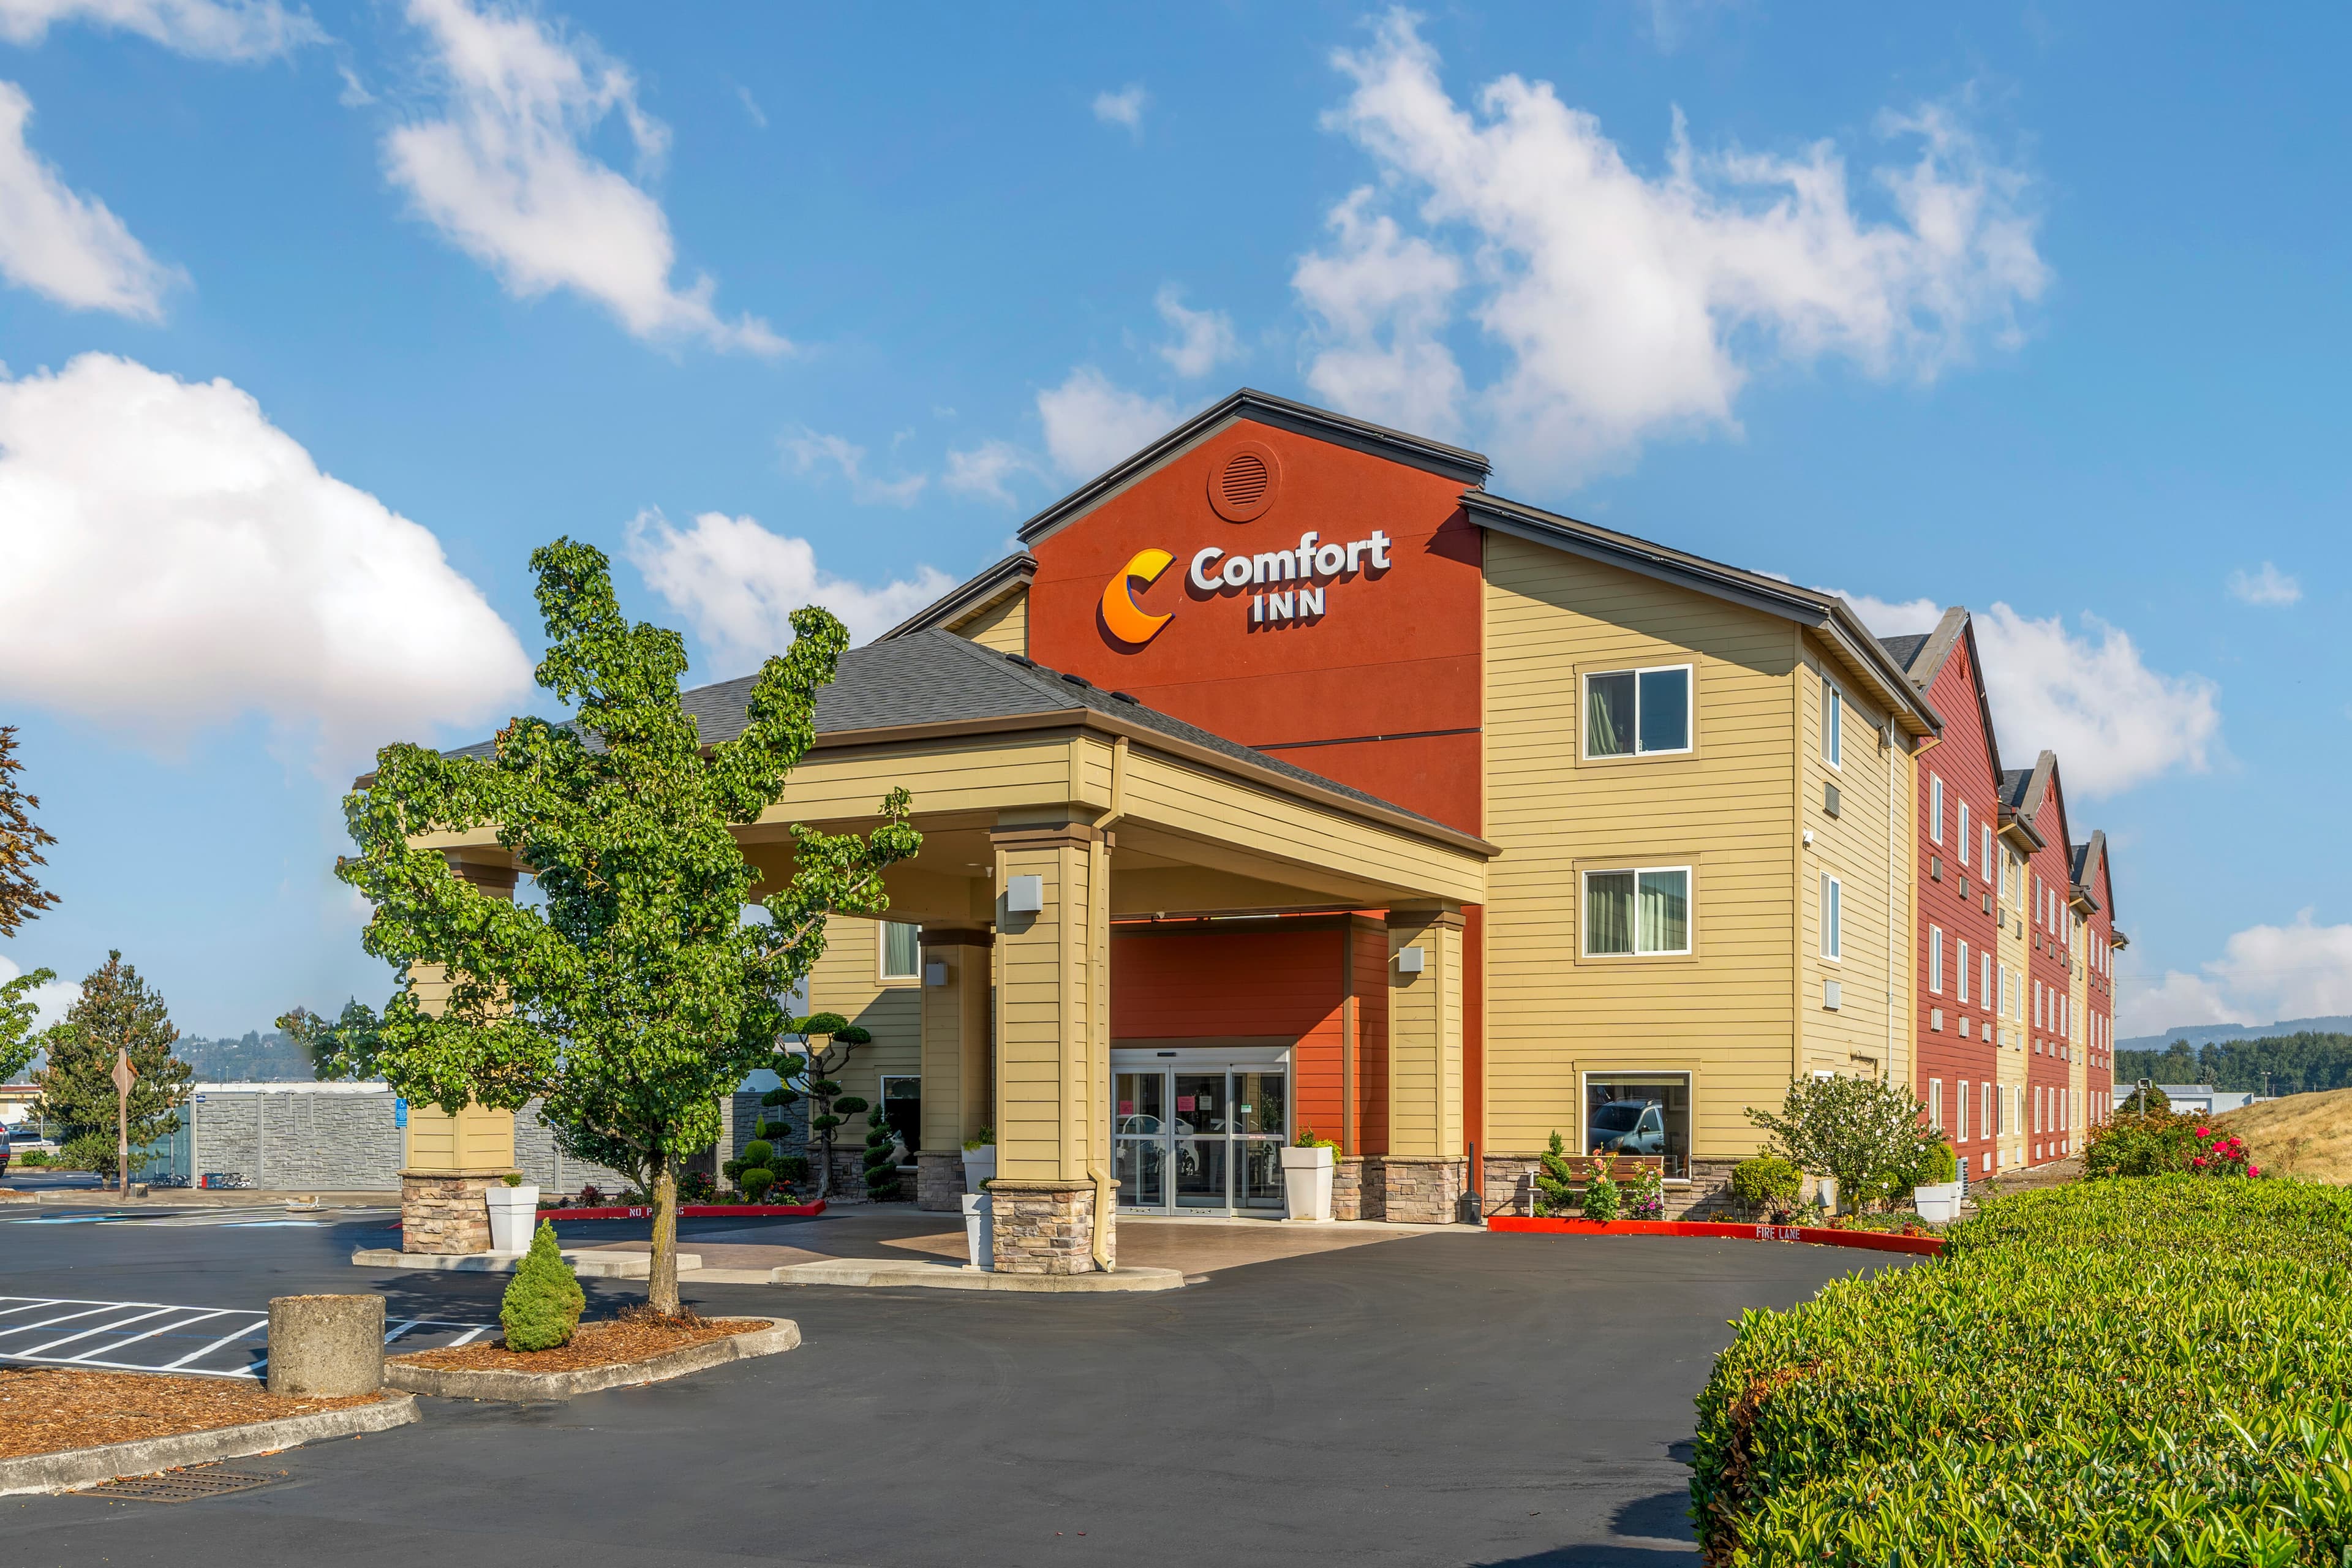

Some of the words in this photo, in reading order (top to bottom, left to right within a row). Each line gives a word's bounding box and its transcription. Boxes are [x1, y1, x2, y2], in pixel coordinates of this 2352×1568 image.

[1190, 530, 1392, 590] Comfort
[1254, 587, 1325, 623] INN
[629, 1208, 641, 1217] NO
[1756, 1226, 1775, 1240] FIRE
[1779, 1227, 1800, 1240] LANE
